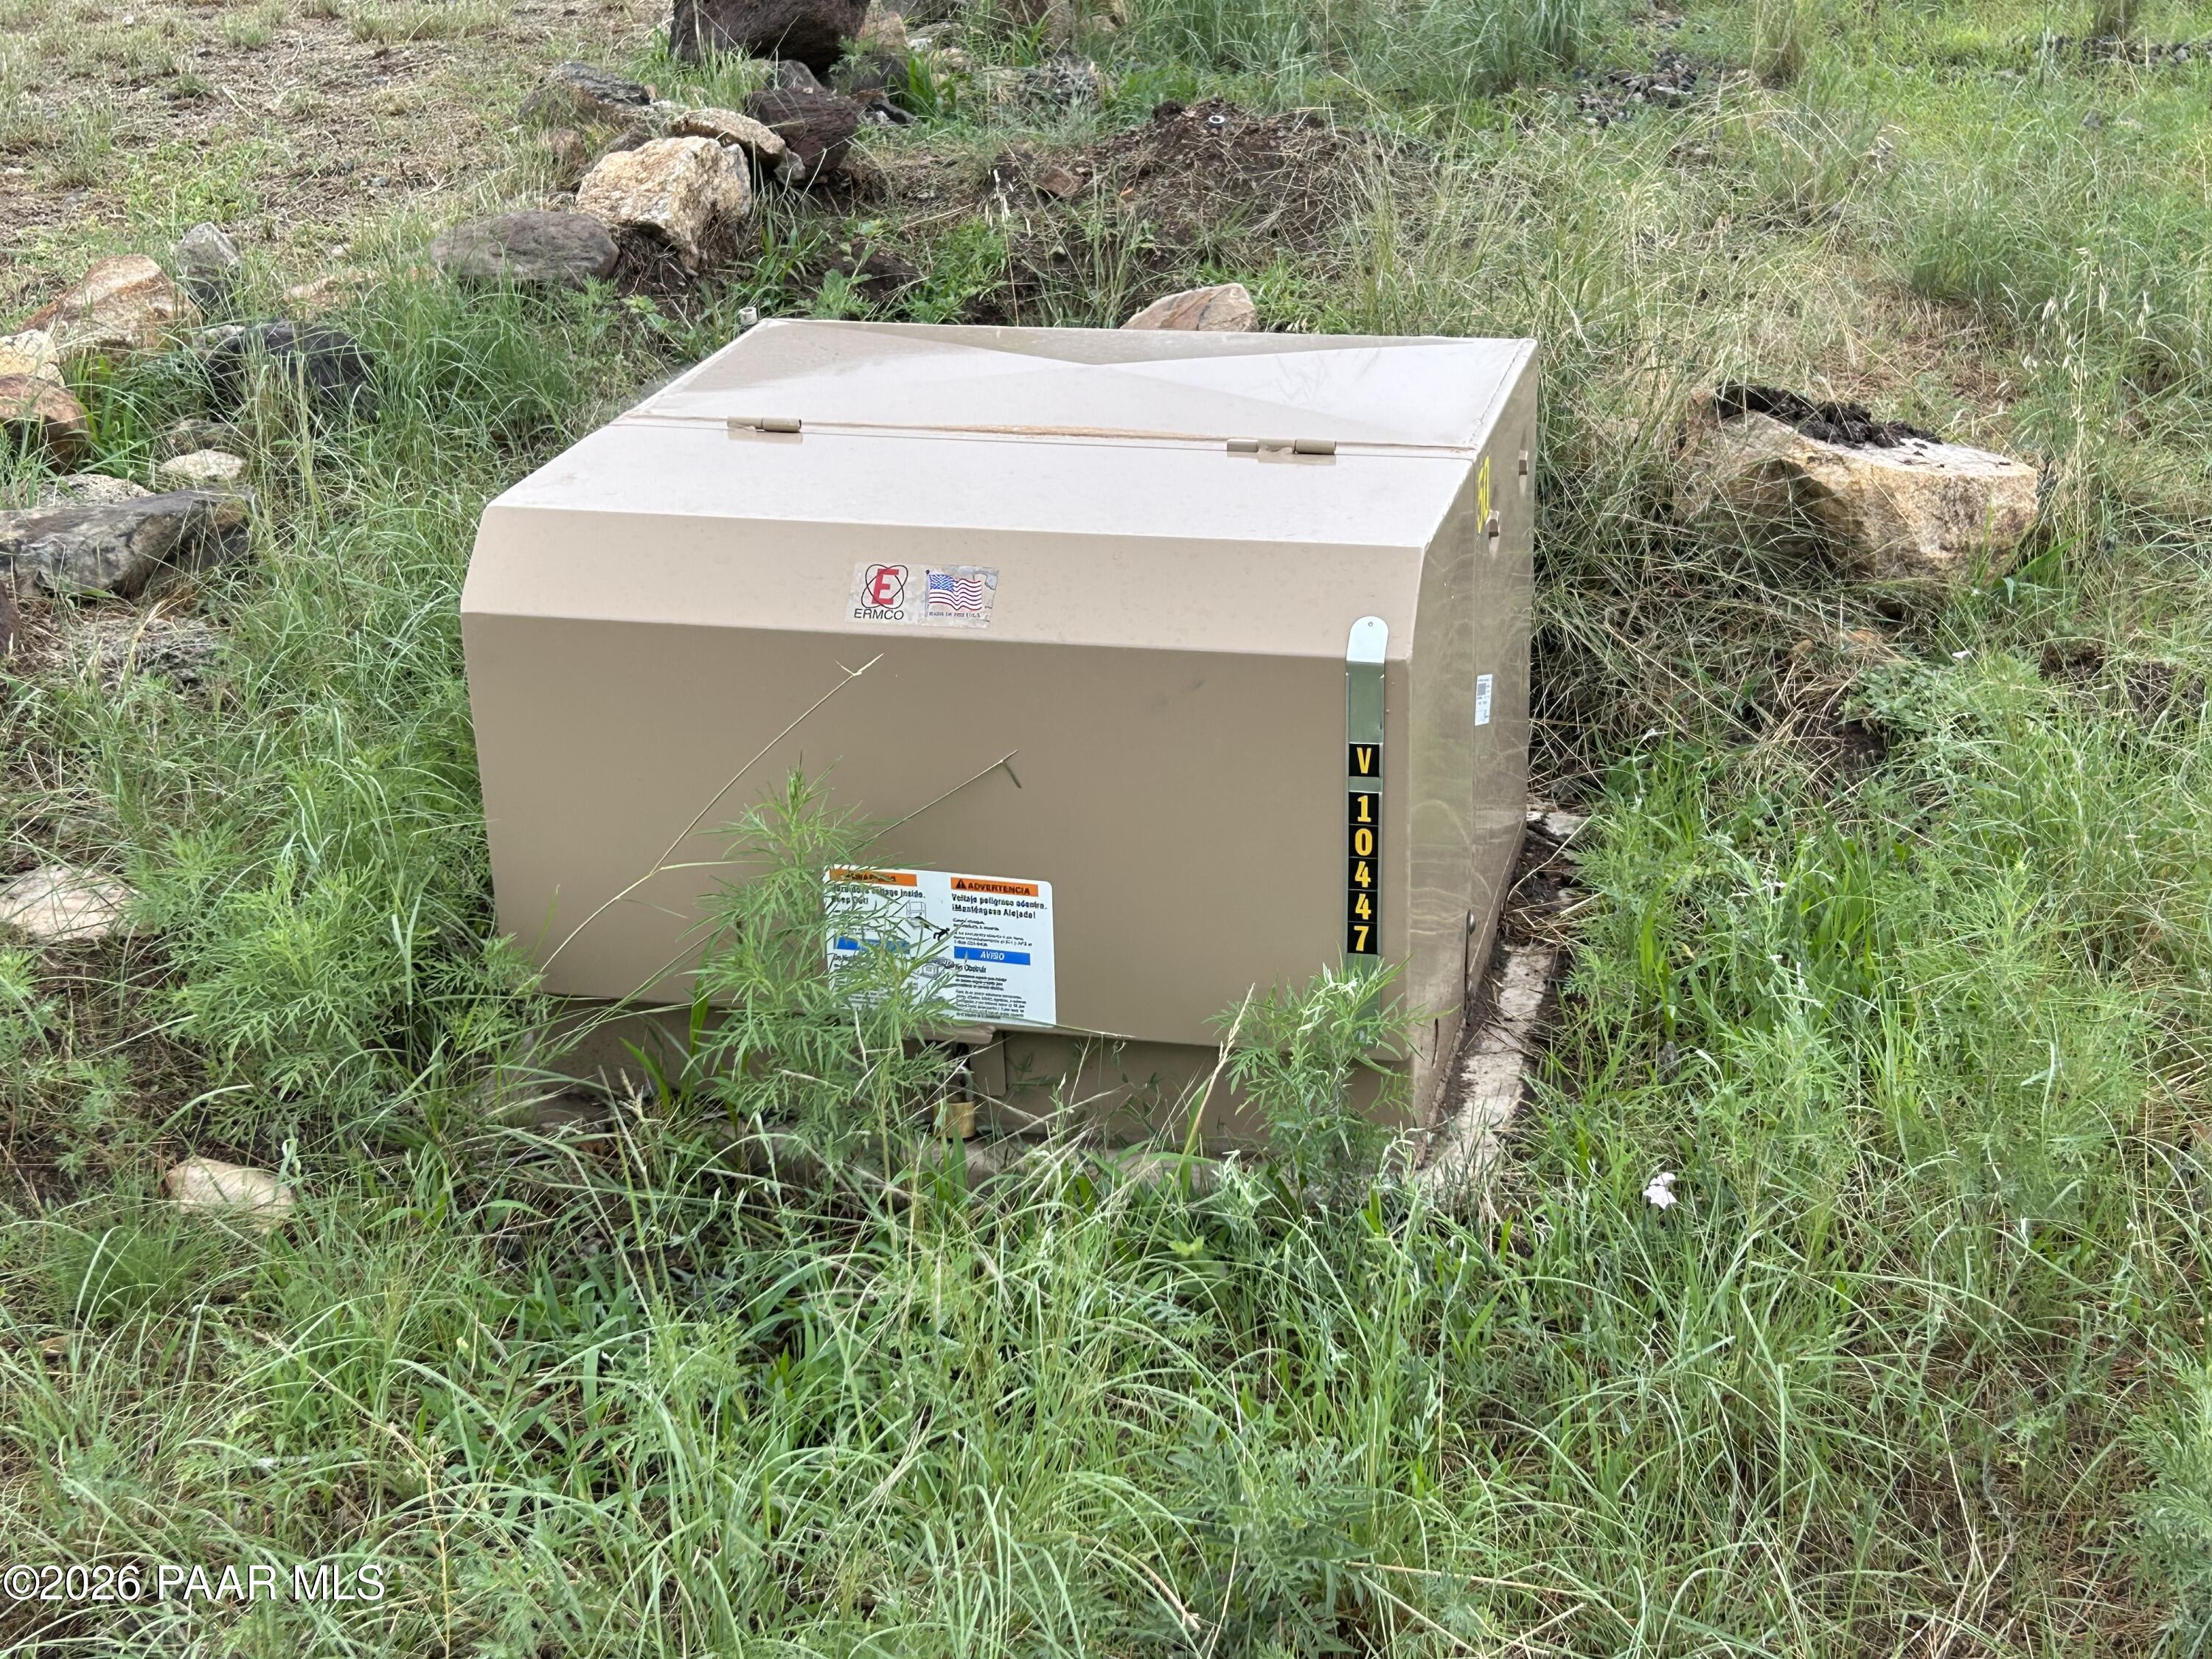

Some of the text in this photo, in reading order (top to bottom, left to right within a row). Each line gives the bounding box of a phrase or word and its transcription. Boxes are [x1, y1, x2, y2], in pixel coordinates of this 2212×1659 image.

[871, 568, 900, 605] E
[854, 608, 904, 620] ERMCO
[1356, 747, 1371, 773] V
[1354, 795, 1372, 951] 10447
[900, 888, 926, 898] inside.
[967, 883, 1030, 895] ADVERTENCIA
[952, 893, 978, 903] Voltaje
[980, 896, 1015, 906] peligroso
[1004, 908, 1036, 919] Alejado!
[980, 950, 1005, 961] AVISO
